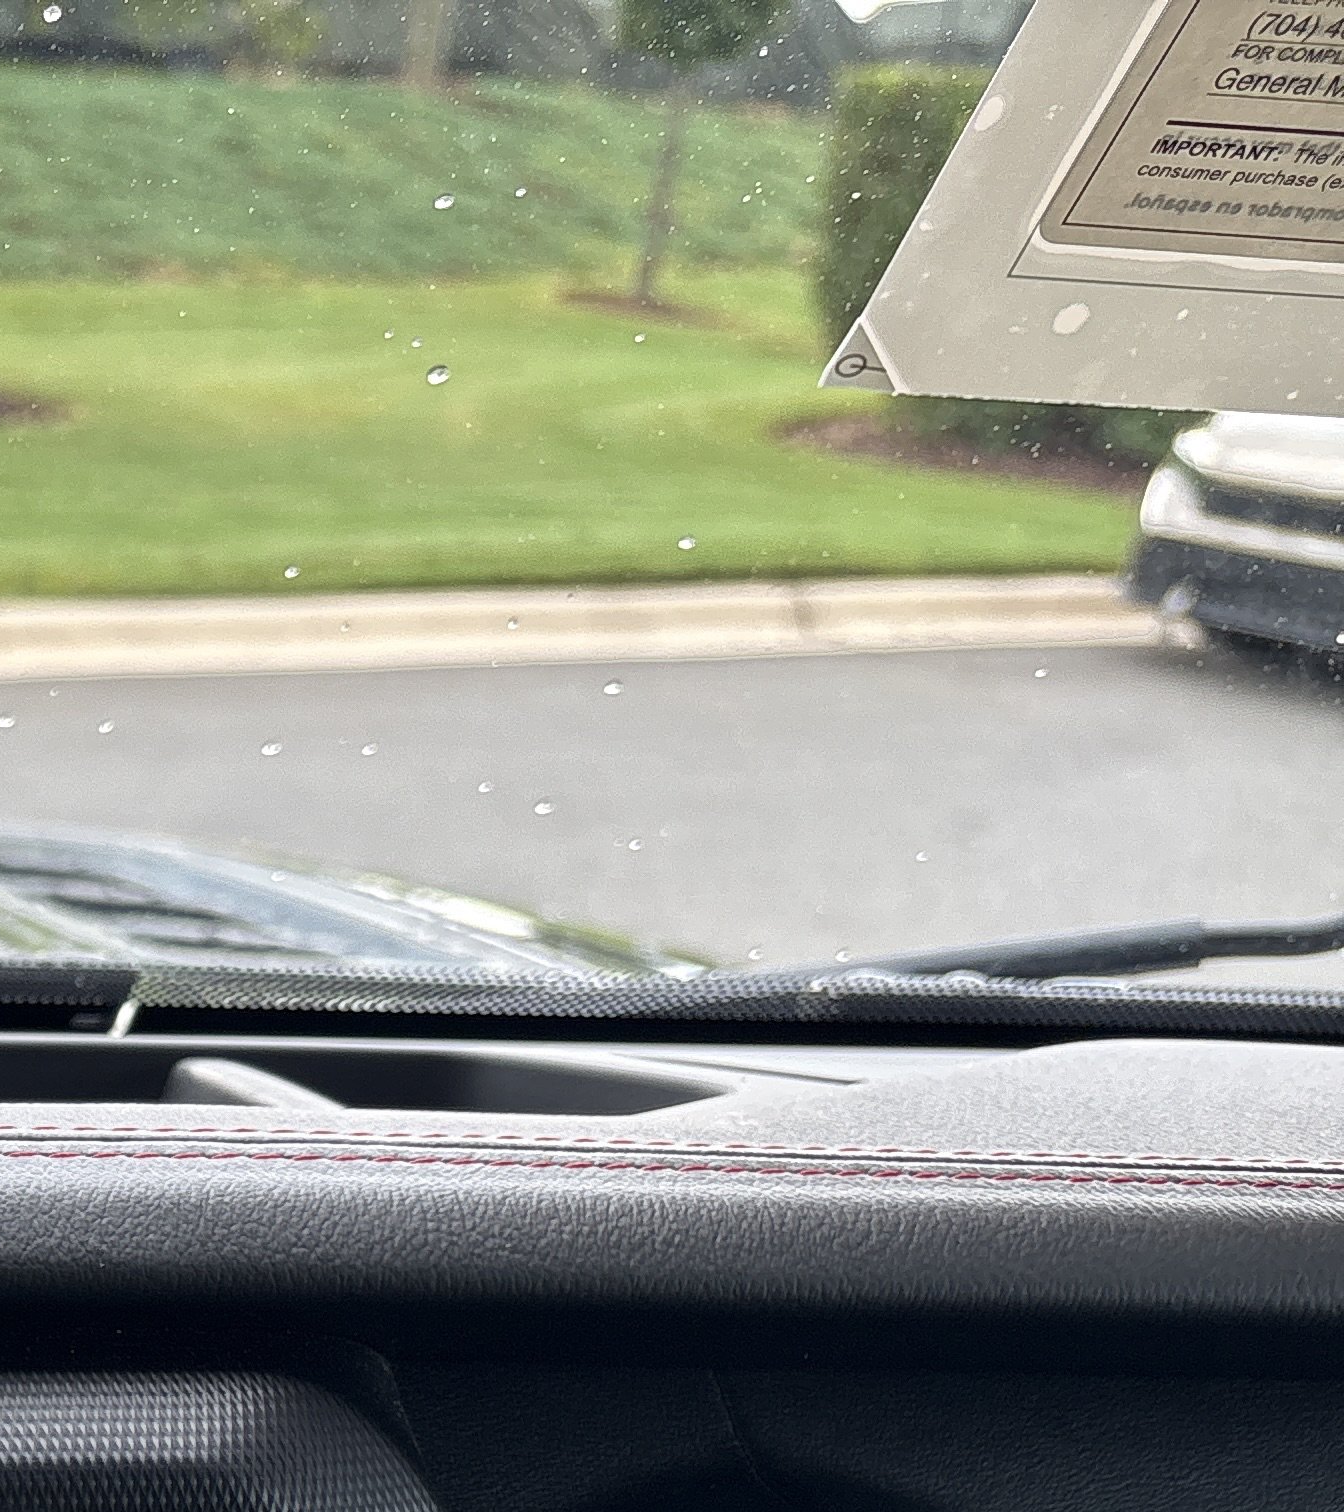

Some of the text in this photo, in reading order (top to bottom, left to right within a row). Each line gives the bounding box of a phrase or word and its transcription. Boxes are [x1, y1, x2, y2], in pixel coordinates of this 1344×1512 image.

[1246, 10, 1321, 43] (704)
[1231, 43, 1275, 61] FOR
[1214, 66, 1324, 96] General
[1150, 137, 1284, 162] IMPORTANT:
[1294, 148, 1327, 166] The
[1137, 163, 1231, 182] consumer
[1229, 170, 1319, 187] purchase
